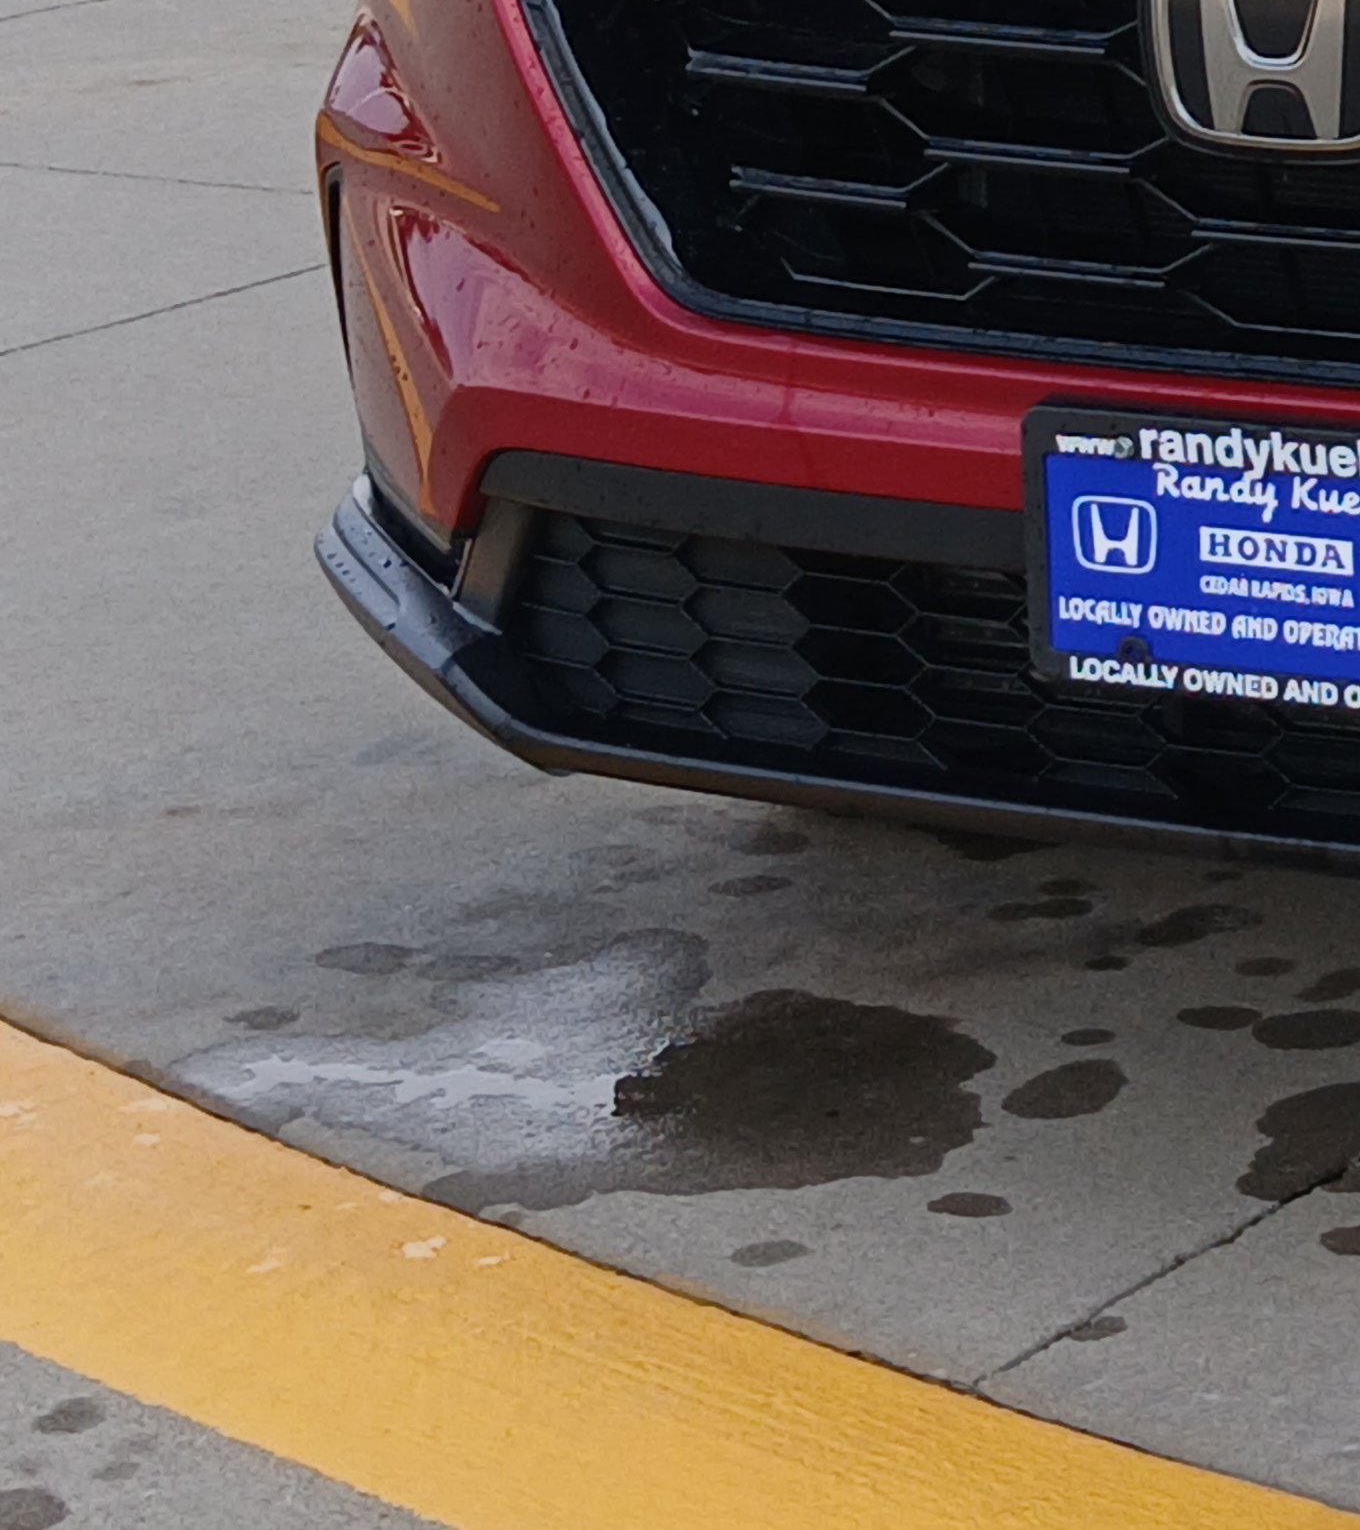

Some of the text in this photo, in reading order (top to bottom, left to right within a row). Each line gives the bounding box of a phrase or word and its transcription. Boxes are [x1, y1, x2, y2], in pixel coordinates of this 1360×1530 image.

[1153, 462, 1279, 523] Randy
[1207, 533, 1346, 570] HONDA
[1200, 575, 1248, 597] CEDAR
[1311, 586, 1355, 608] IOWA
[1058, 597, 1143, 629] LOCALLY
[1147, 606, 1227, 636] OWNED
[1231, 615, 1278, 641] AND
[1069, 655, 1179, 689] LOCALLY
[1183, 668, 1279, 700] OWNED
[1283, 678, 1339, 707] AND
